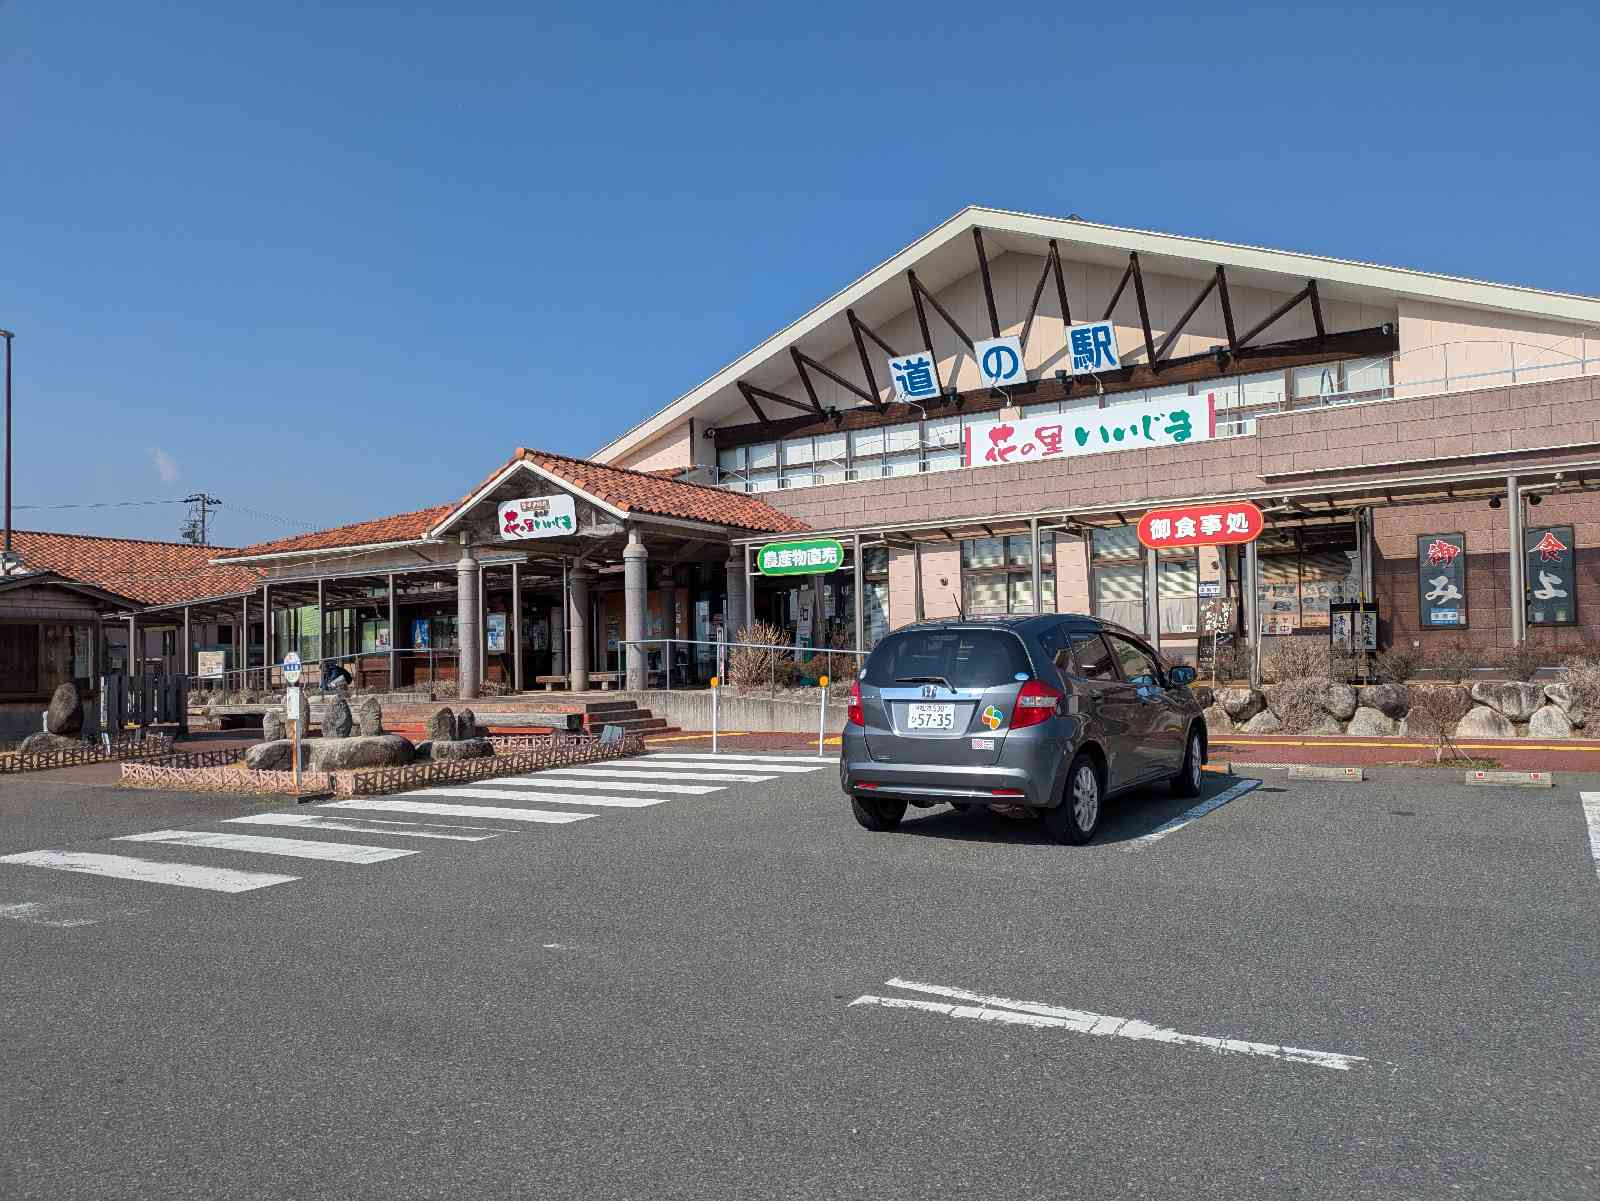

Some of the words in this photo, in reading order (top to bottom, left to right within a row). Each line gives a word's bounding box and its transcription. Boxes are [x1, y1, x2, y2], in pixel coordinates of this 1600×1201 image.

[893, 325, 1117, 397] 道の駅
[985, 409, 1192, 462] 花の里いいじま
[1150, 512, 1249, 540] 御食事処
